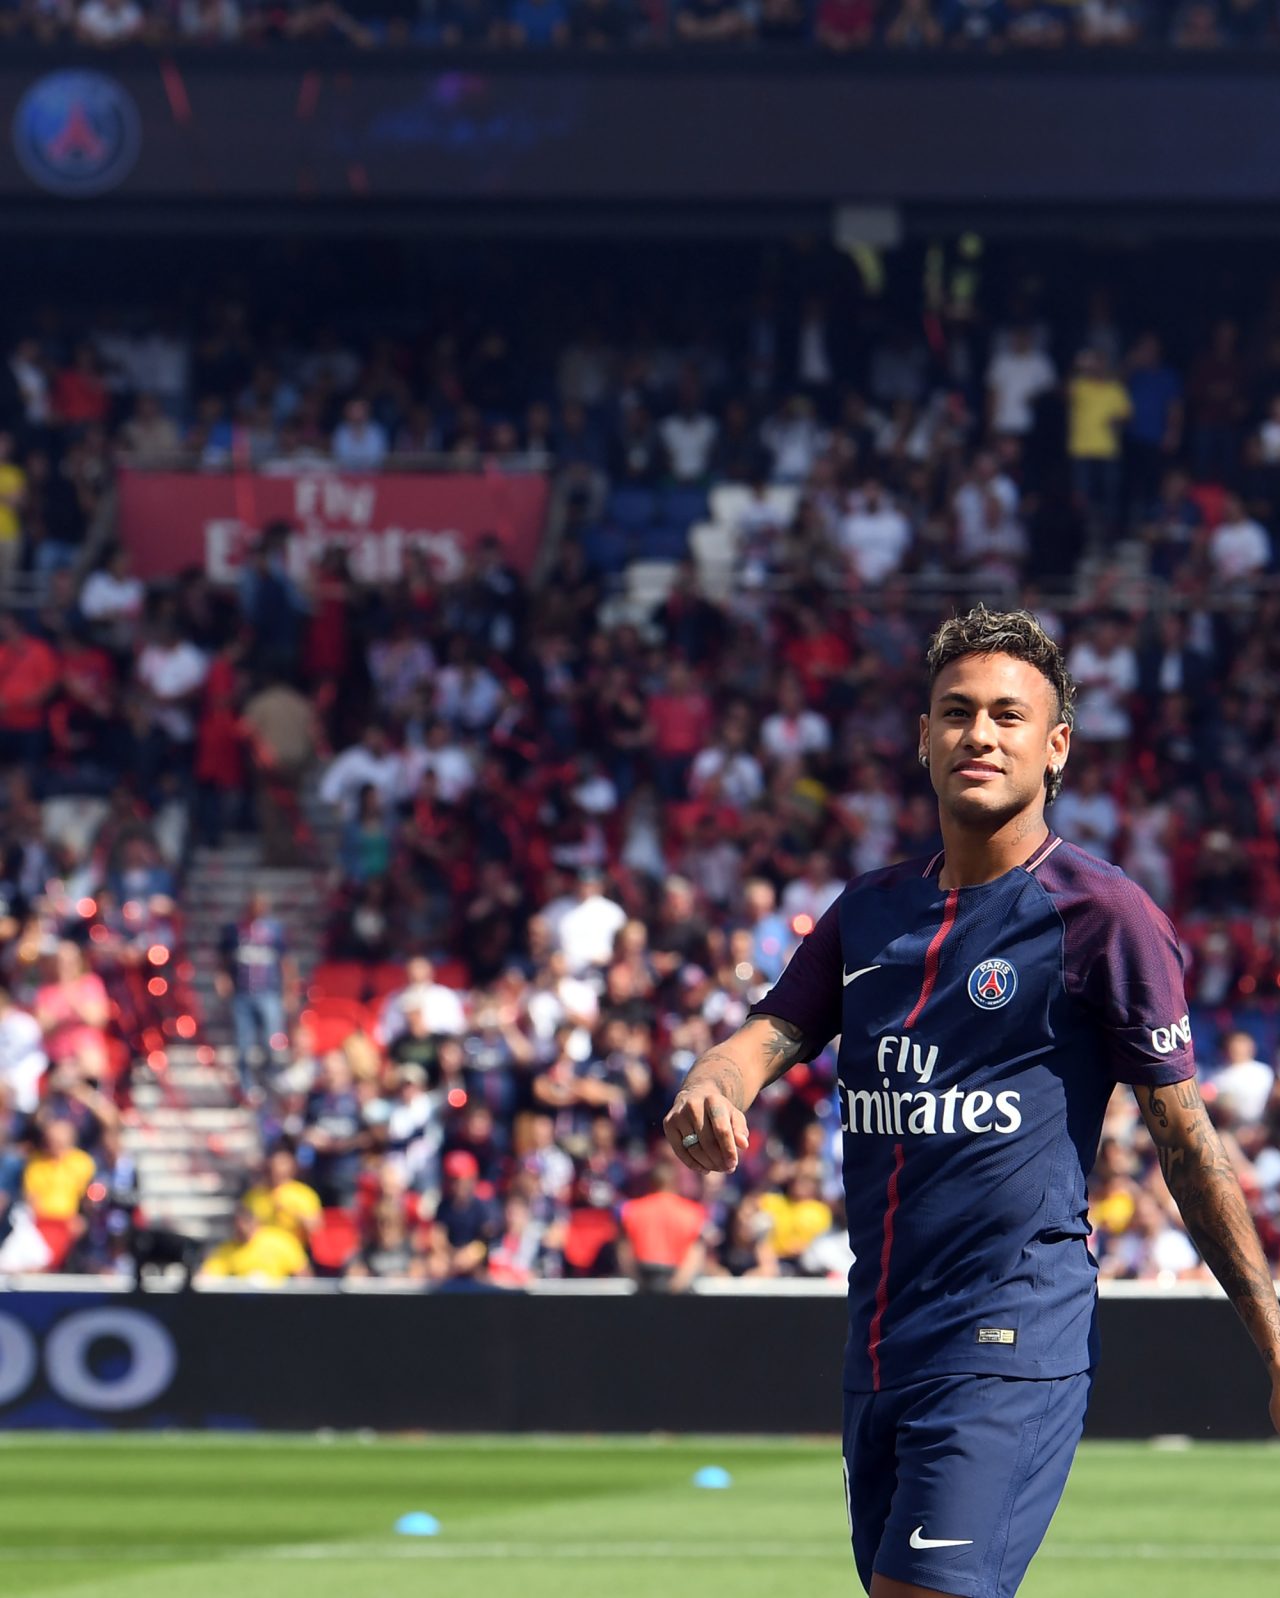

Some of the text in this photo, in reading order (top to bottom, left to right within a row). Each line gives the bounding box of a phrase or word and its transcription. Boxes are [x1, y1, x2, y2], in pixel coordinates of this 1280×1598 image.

[980, 961, 1011, 975] PARIS
[1151, 1014, 1192, 1054] QNB
[877, 1036, 939, 1083] Fly
[838, 1077, 1022, 1135] mirates
